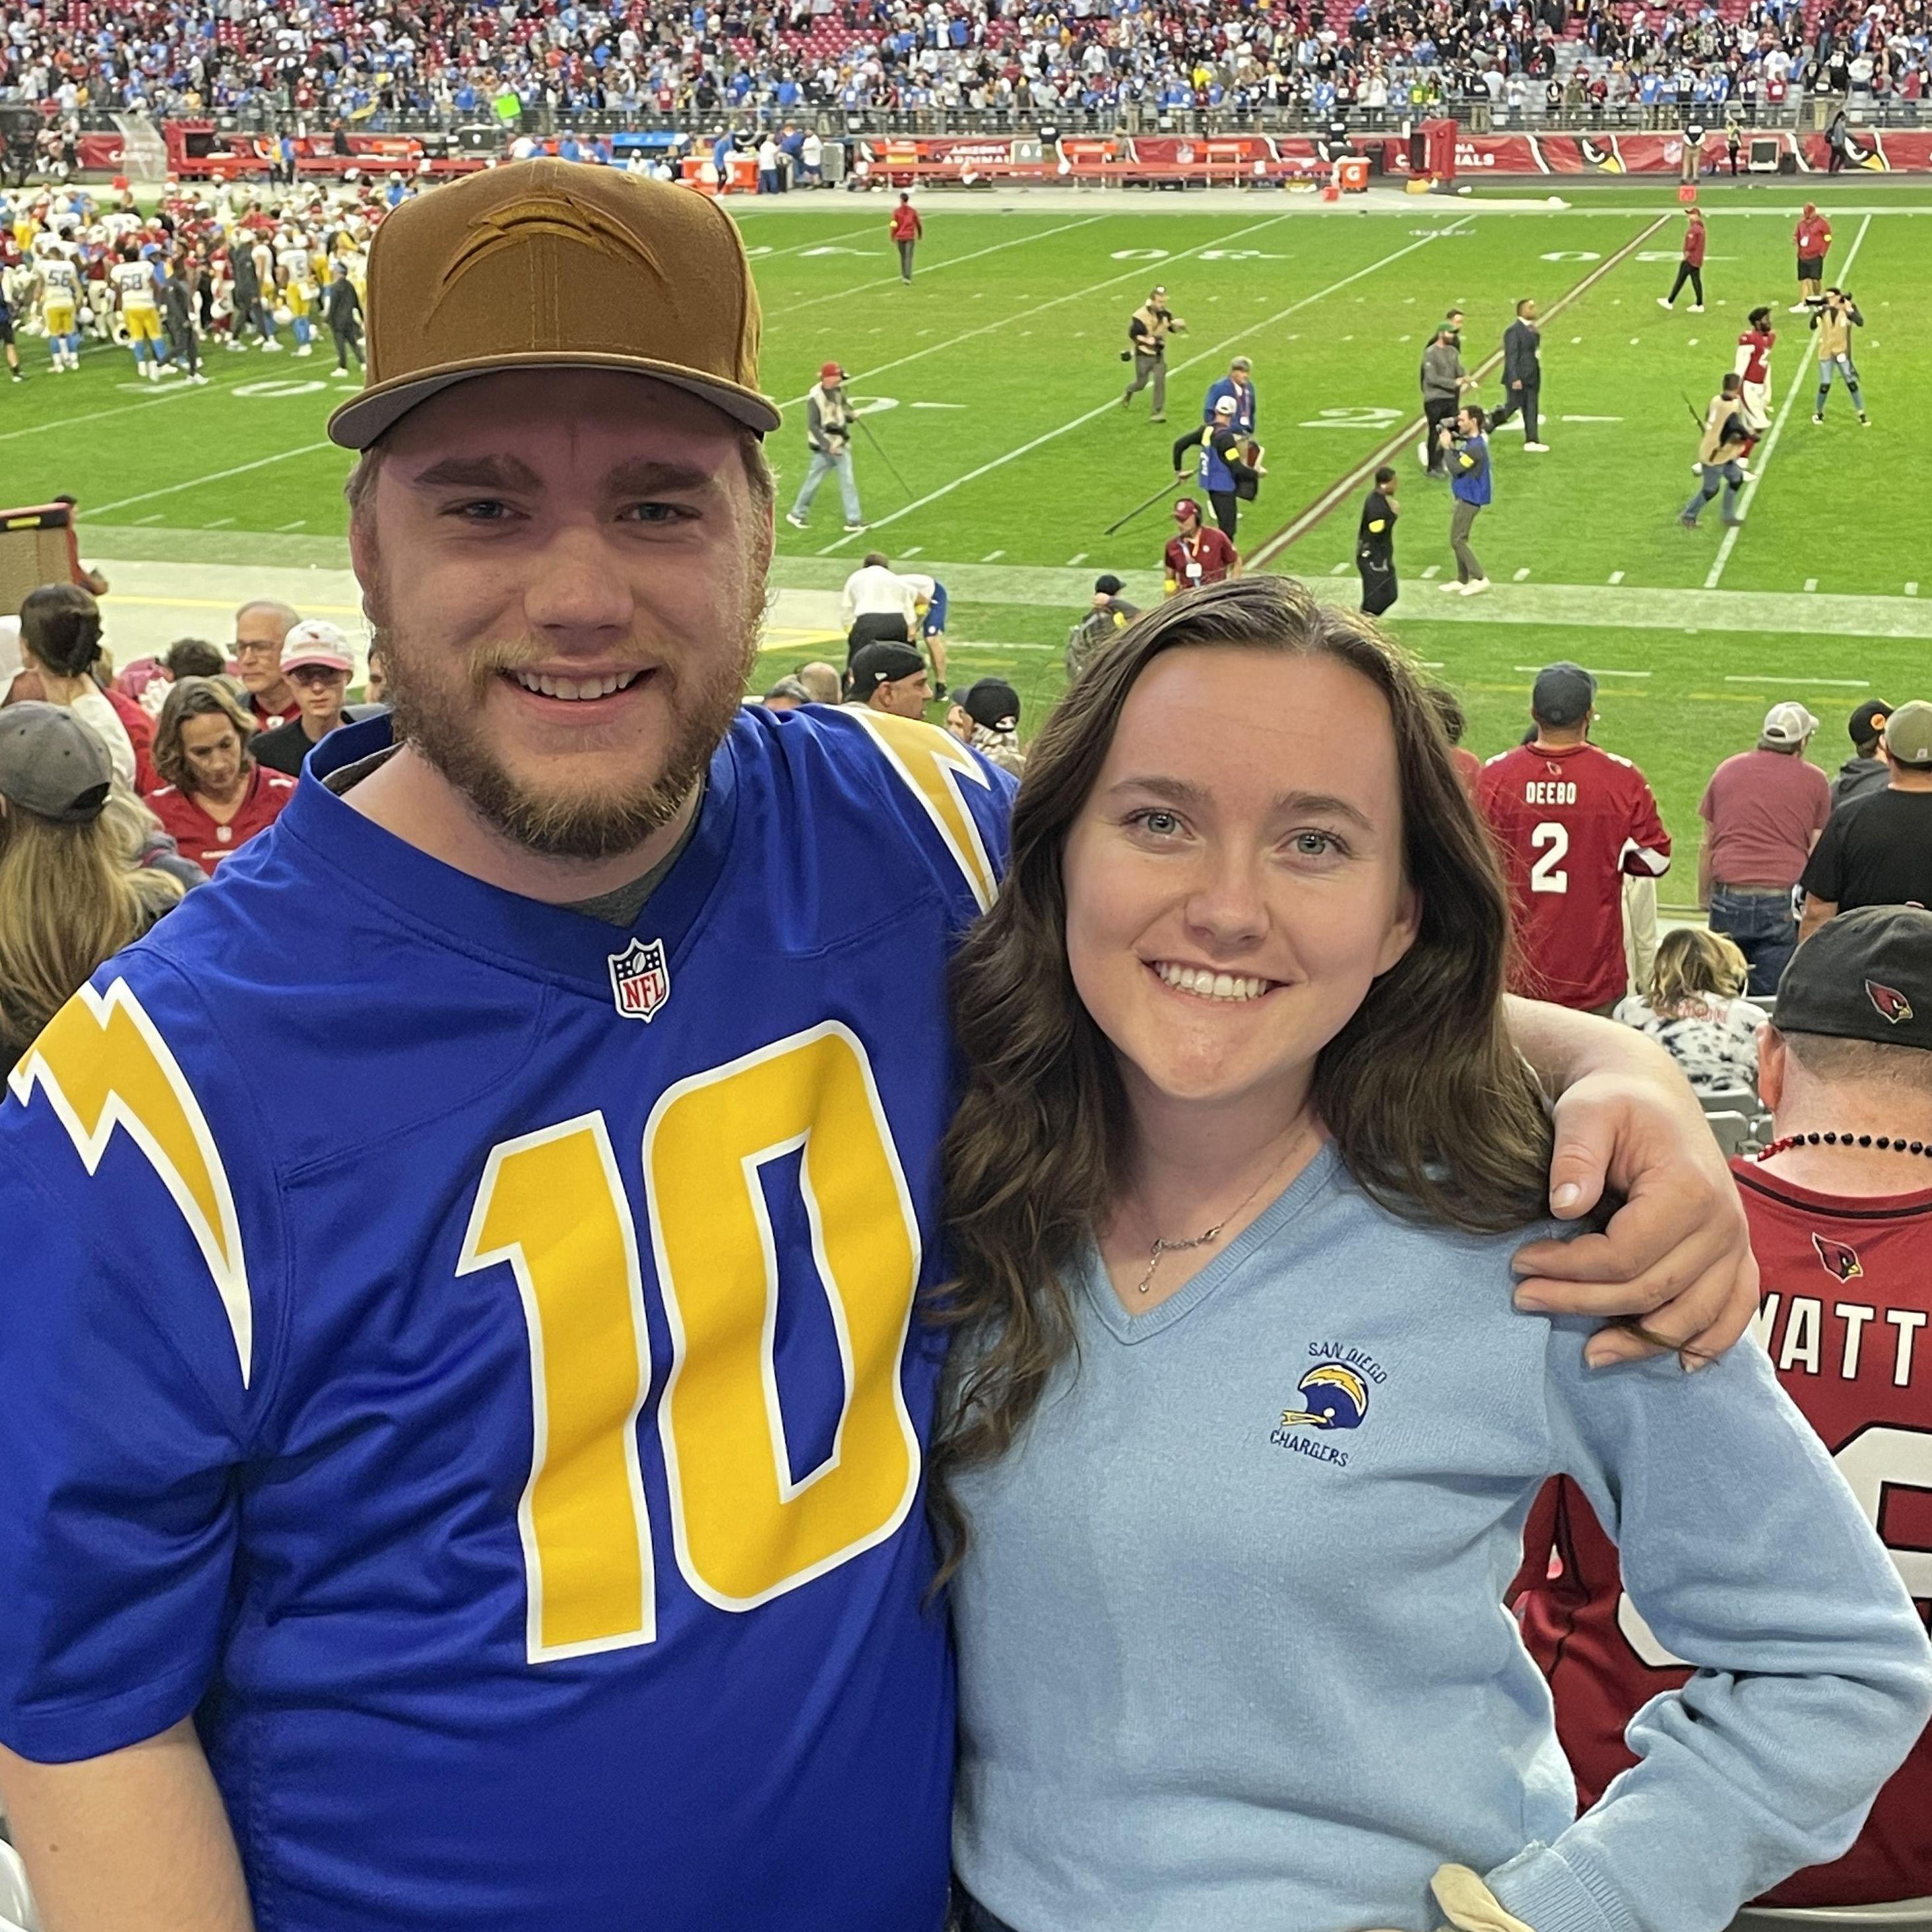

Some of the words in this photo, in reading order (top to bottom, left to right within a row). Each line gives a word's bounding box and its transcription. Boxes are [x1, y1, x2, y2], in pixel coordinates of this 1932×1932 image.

[1531, 822, 1568, 894] 2
[622, 973, 664, 1008] NFL
[455, 1019, 922, 1665] 10
[1308, 1341, 1343, 1359] SAN
[1345, 1347, 1388, 1384] DIEGO
[1270, 1429, 1349, 1467] CHARGERS
